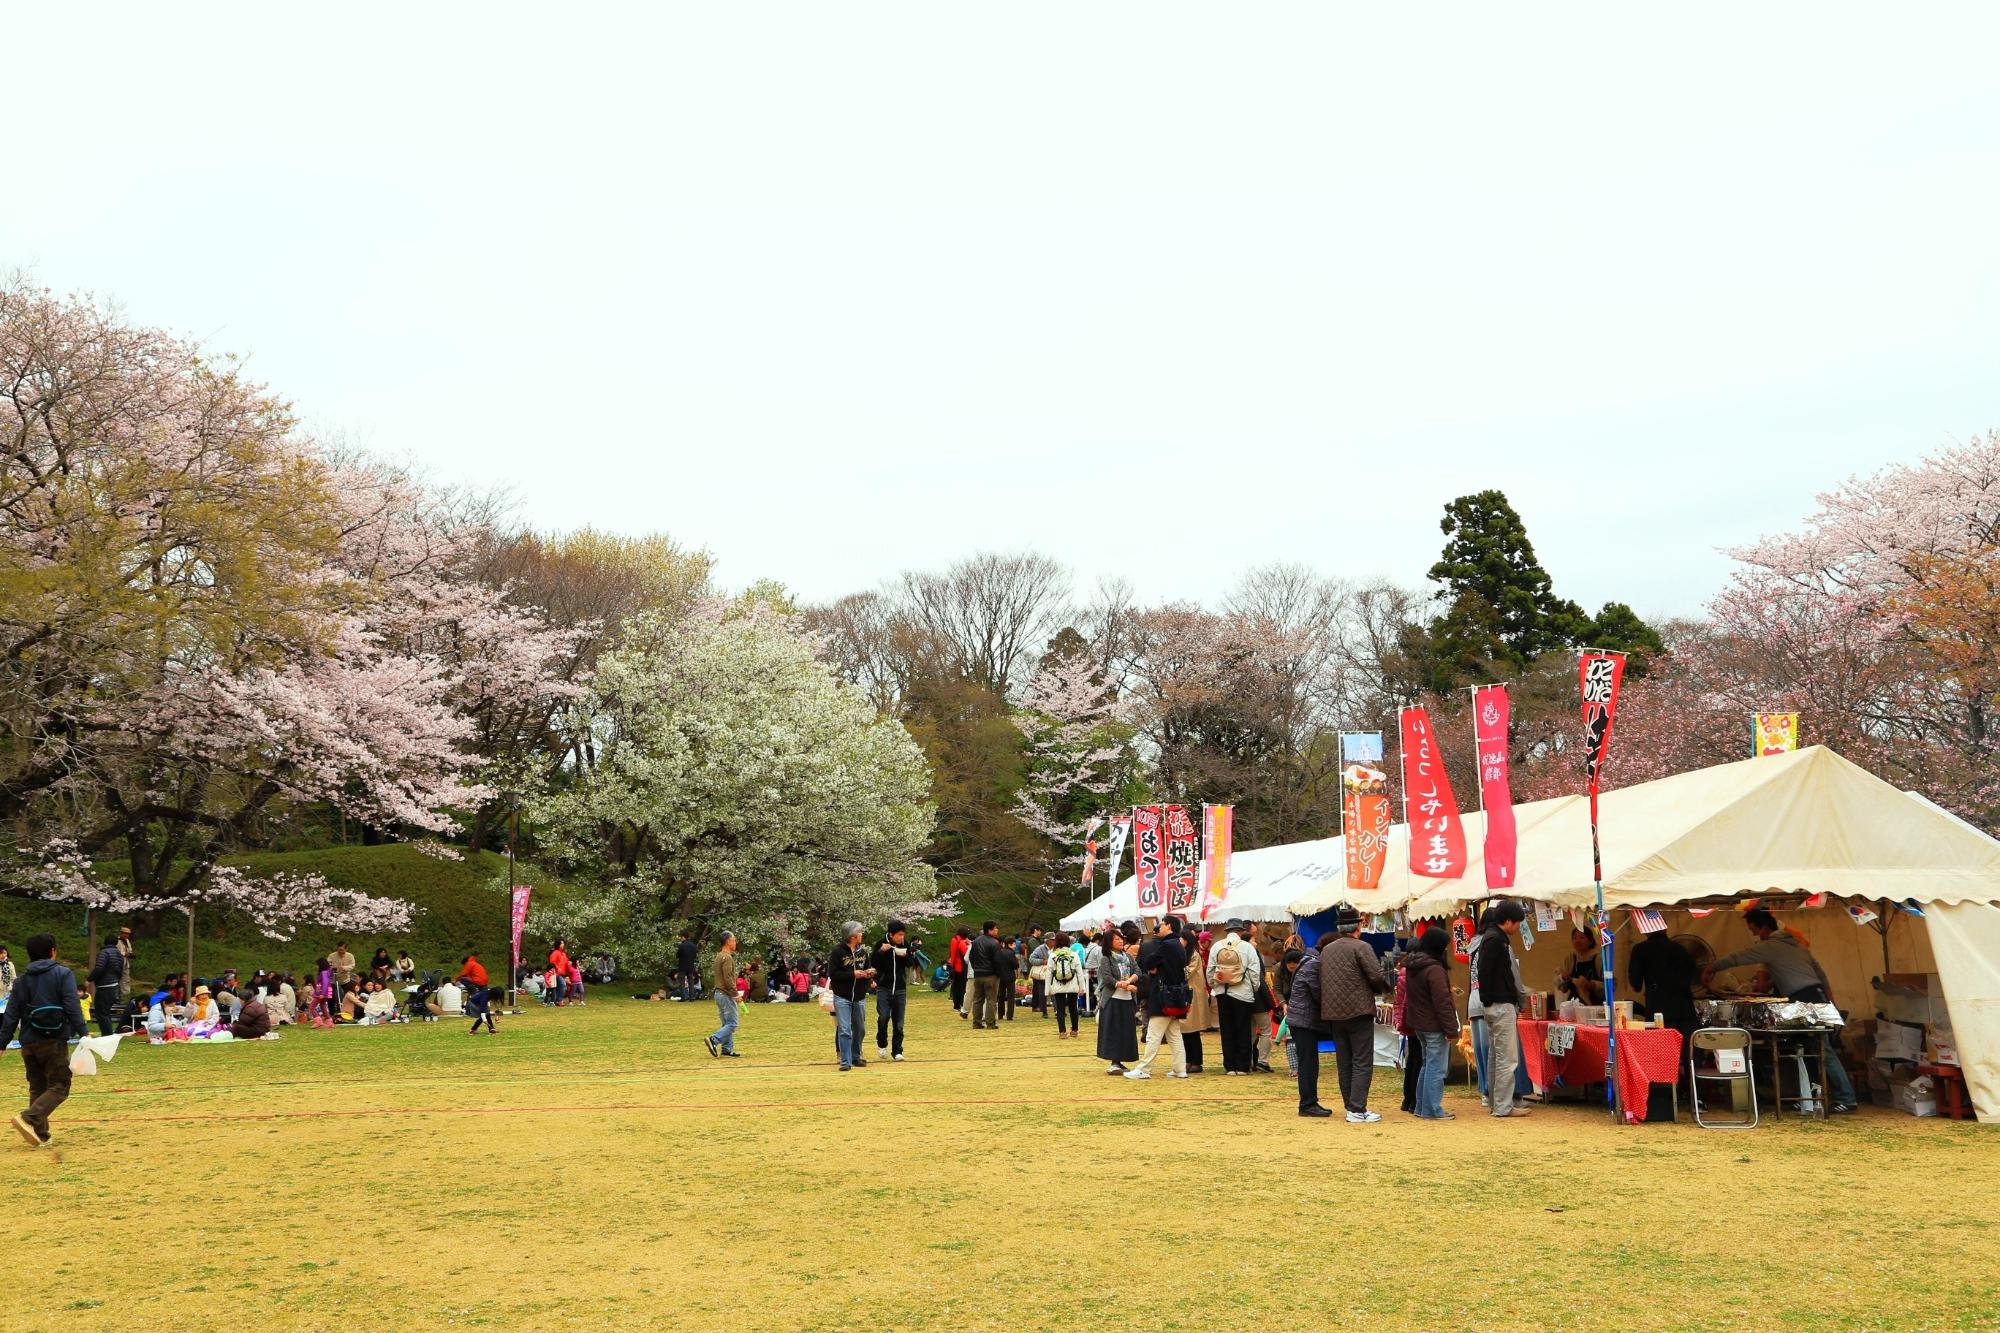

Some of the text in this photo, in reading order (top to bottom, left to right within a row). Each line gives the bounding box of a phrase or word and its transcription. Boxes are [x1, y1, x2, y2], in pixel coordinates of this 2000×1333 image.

[1168, 840, 1193, 909] 焼そば
[1358, 798, 1391, 883] インド カレー
